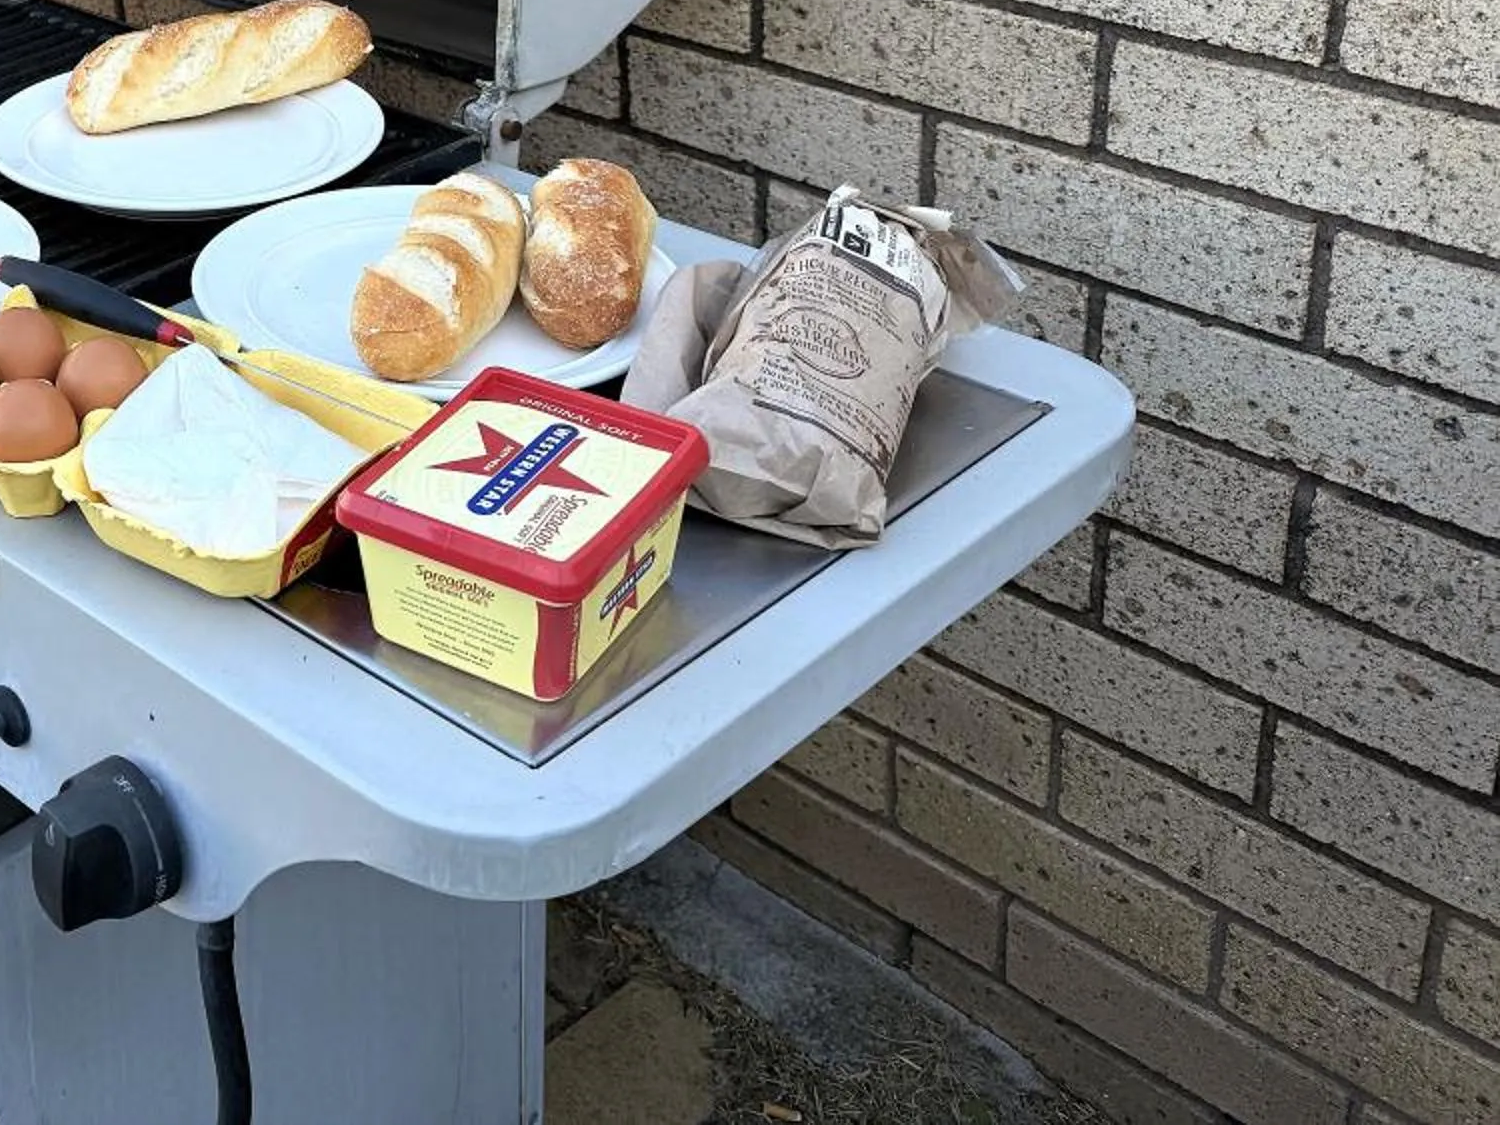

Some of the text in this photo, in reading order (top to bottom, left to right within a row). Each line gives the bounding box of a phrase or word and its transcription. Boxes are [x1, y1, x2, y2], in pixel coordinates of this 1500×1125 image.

[519, 396, 644, 441] ORIGINAL SOFT
[510, 427, 573, 478] WESTERN
[475, 477, 516, 508] STAR
[523, 494, 588, 555] Spreadable
[415, 564, 496, 602] Spreadable
